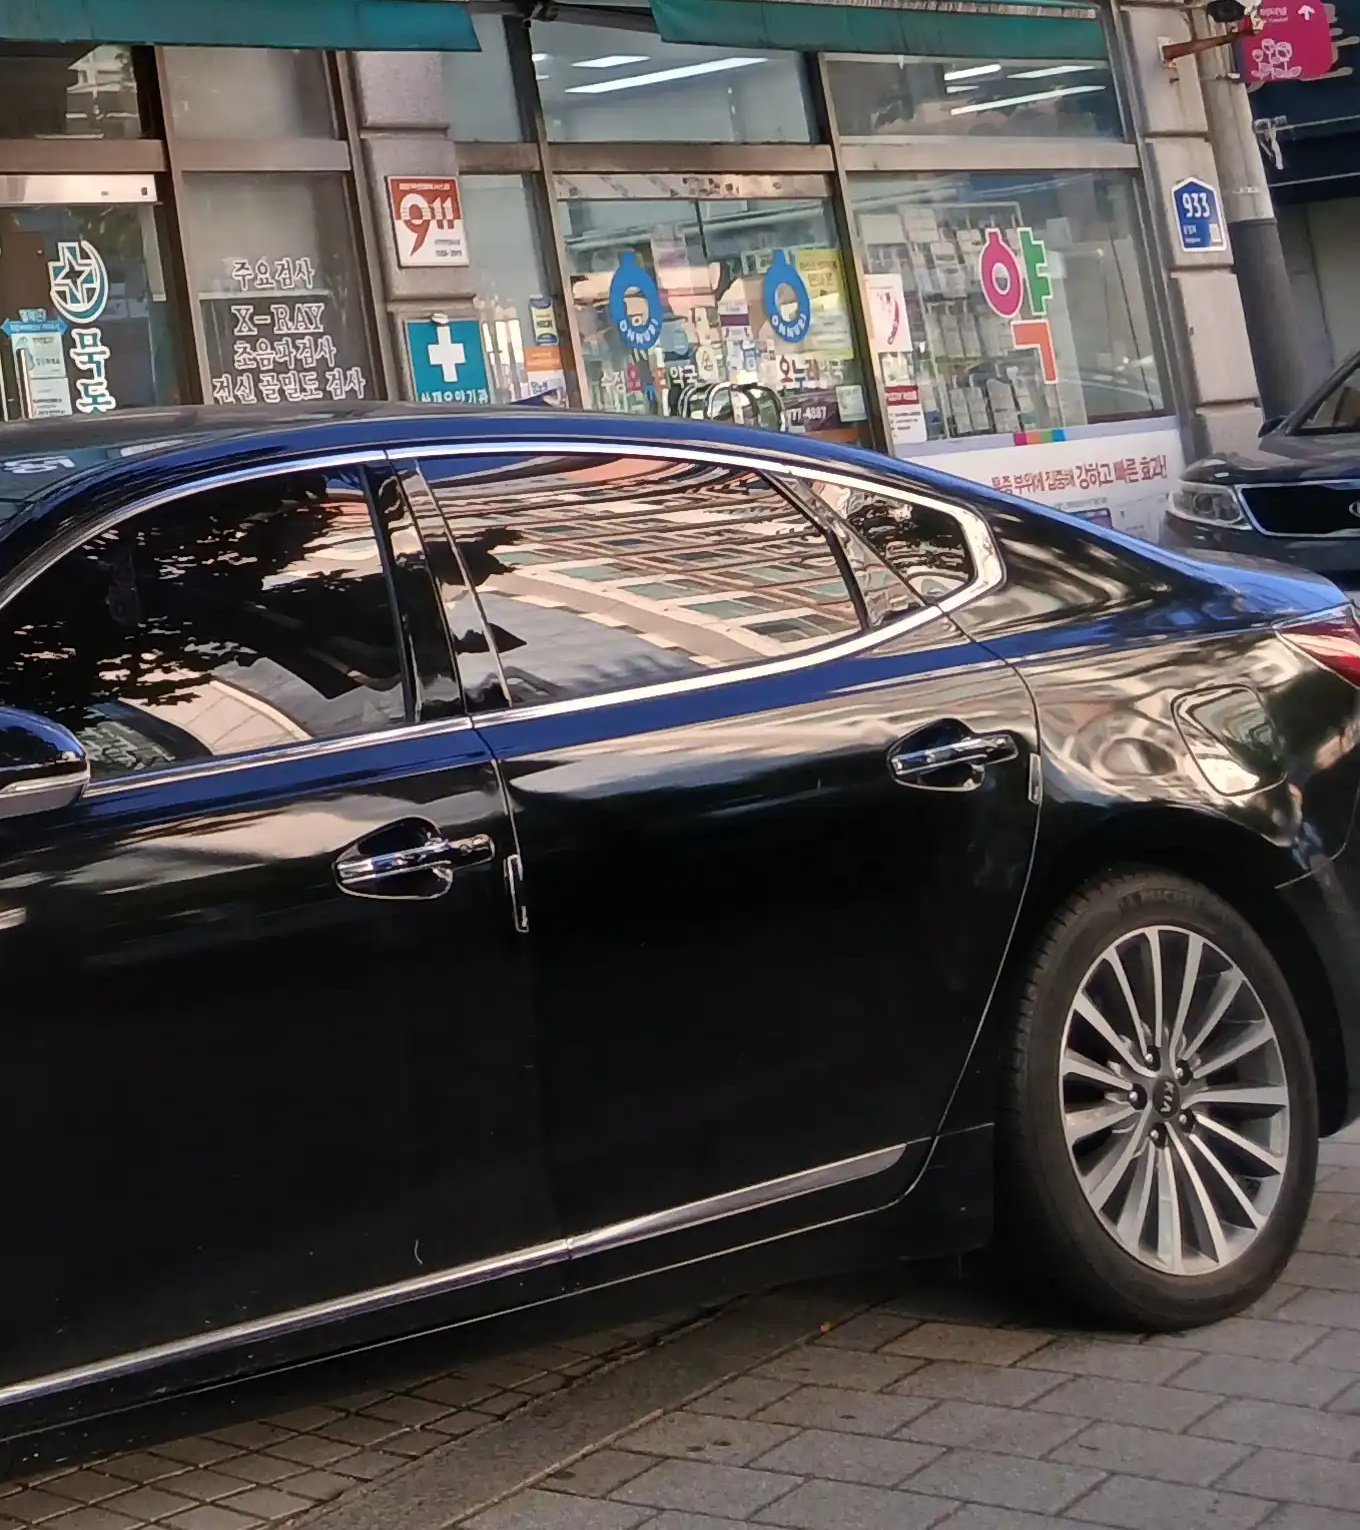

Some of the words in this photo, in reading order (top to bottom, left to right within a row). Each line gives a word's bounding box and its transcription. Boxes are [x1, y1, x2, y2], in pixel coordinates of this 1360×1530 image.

[1182, 192, 1211, 218] 933
[232, 256, 316, 291] 주요검사
[231, 303, 326, 336] X-RAY
[979, 226, 1059, 385] 약
[233, 335, 338, 371] 초음파검사
